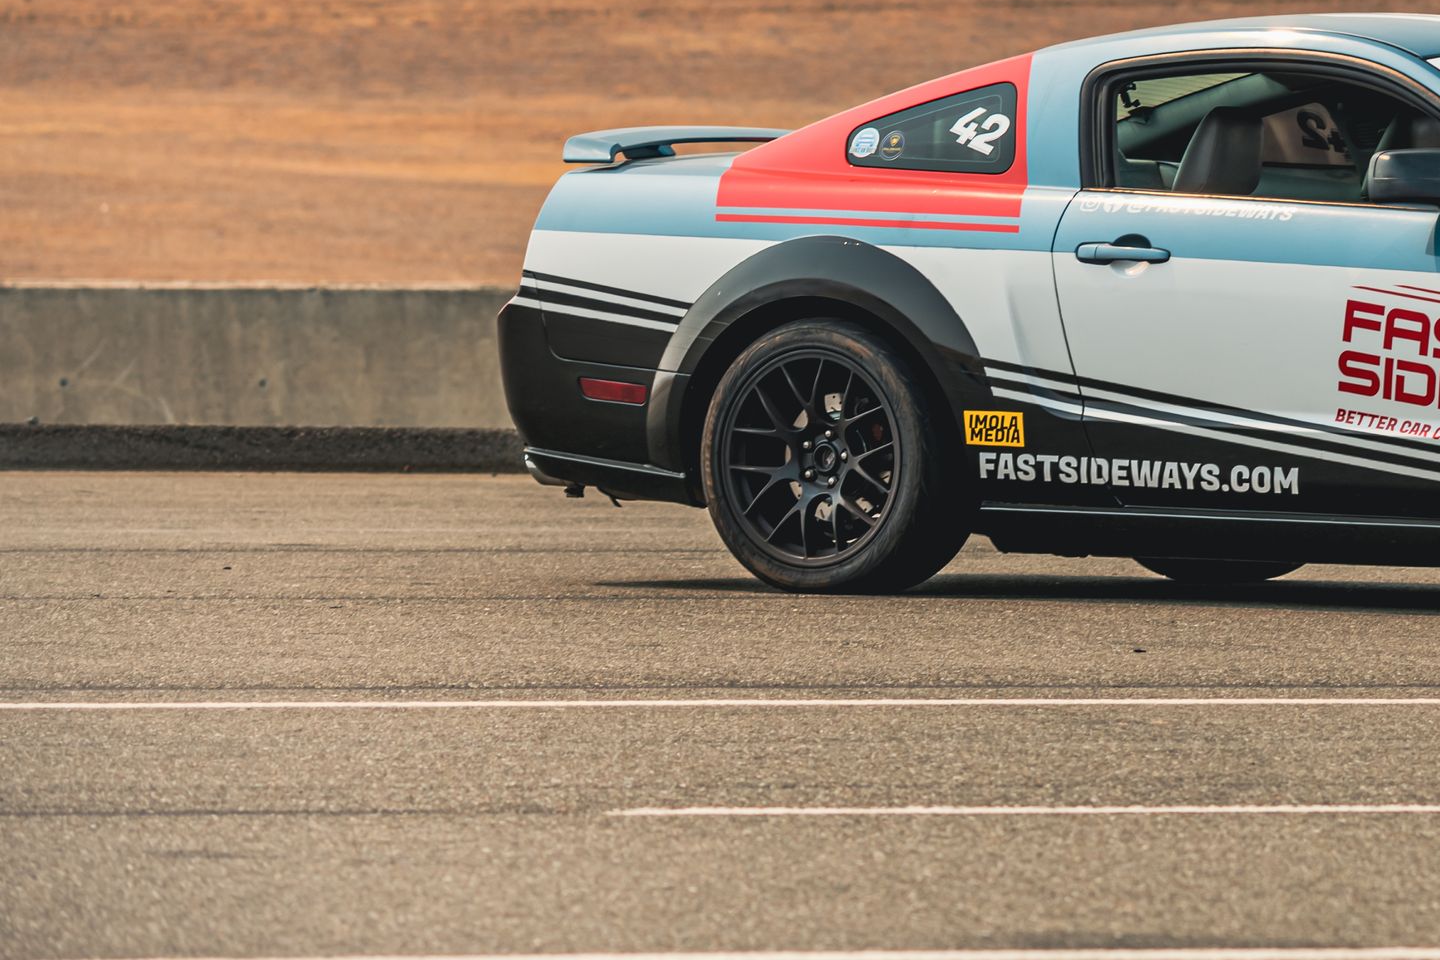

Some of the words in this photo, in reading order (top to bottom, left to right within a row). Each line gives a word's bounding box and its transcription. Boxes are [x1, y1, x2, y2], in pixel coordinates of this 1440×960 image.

[950, 107, 1010, 156] 42
[969, 414, 1017, 430] IMOLA
[970, 427, 1020, 443] MEDIA
[1335, 408, 1398, 431] BETTER
[1400, 420, 1431, 438] CAR
[979, 452, 1299, 494] FASTSIDEWAYS.COM
